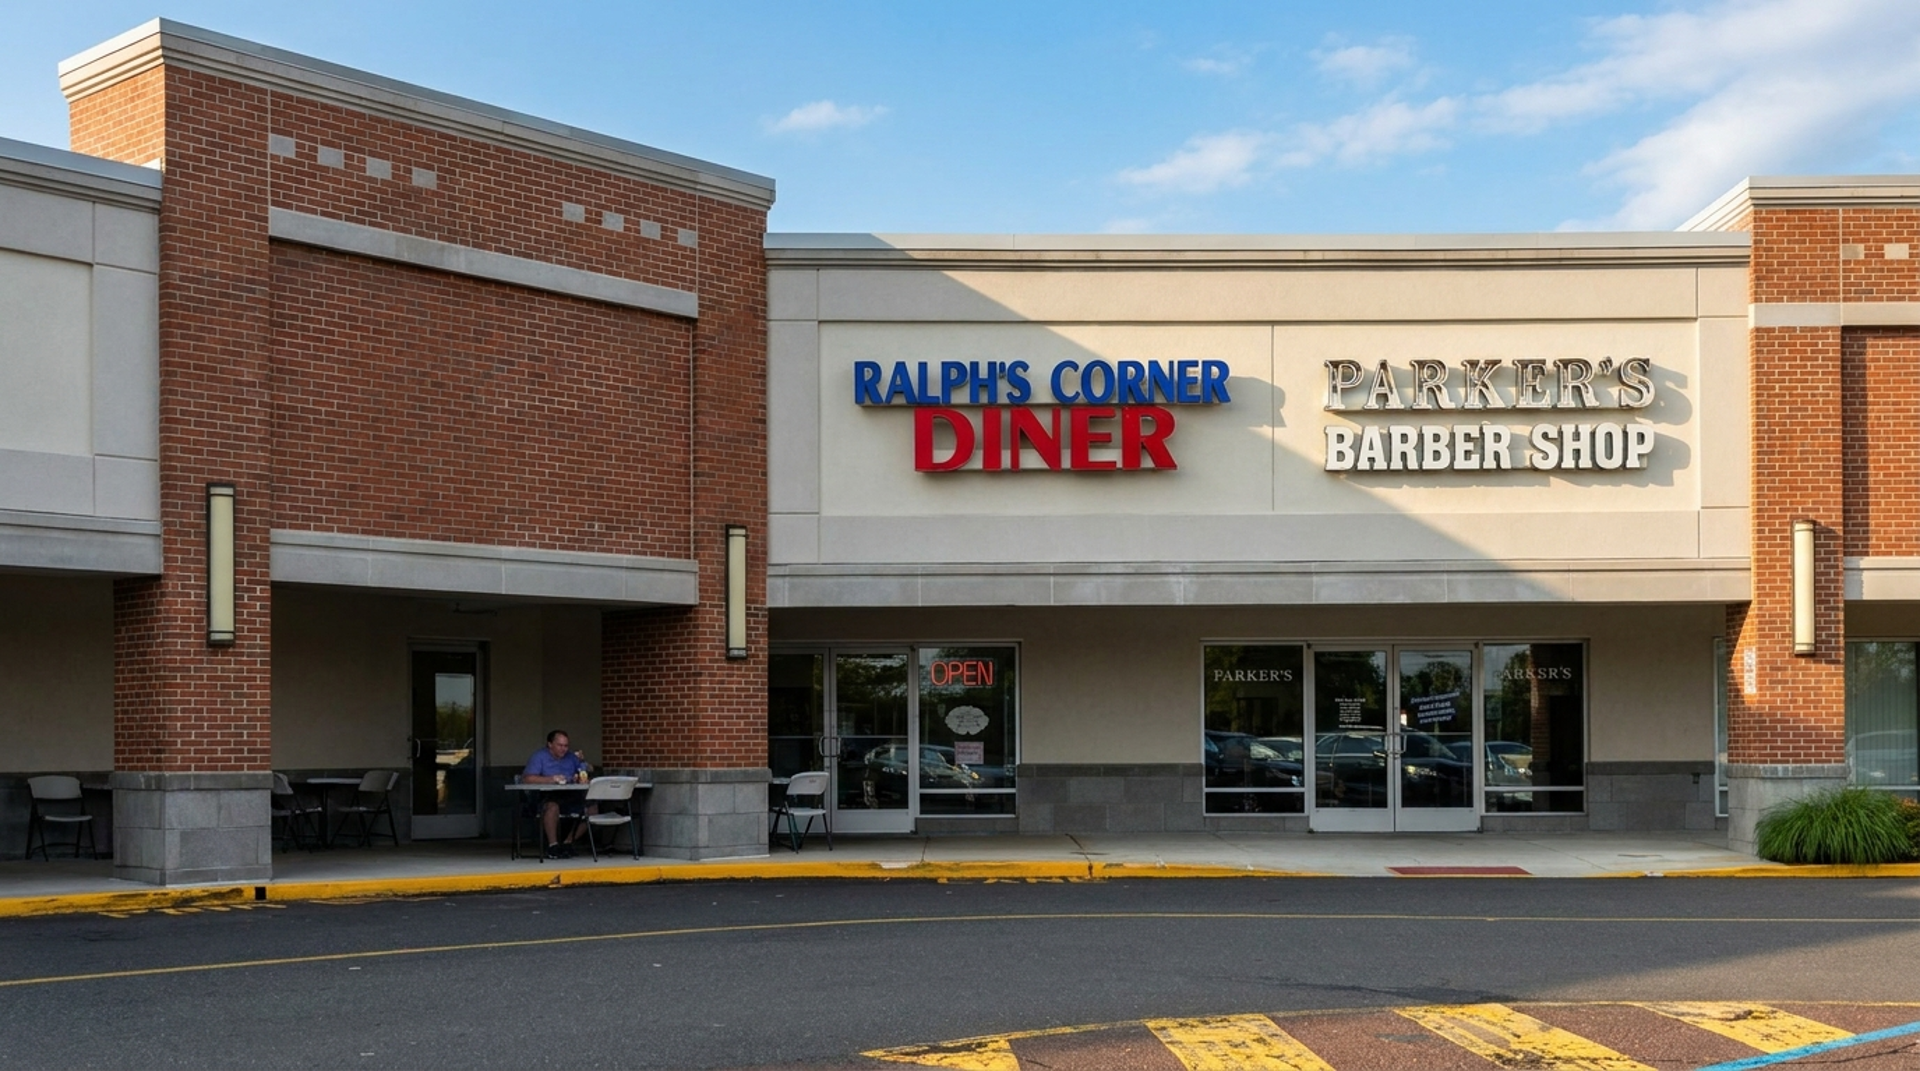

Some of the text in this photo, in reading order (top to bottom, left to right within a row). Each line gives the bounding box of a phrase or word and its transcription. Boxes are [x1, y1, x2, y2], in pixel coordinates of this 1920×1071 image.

[854, 360, 1232, 405] RALPH'S CORNER
[1324, 356, 1656, 411] PARKER'S
[914, 406, 1178, 471] DINER
[1324, 423, 1655, 471] BARBER SHOP
[931, 660, 994, 687] OPEN
[1213, 669, 1293, 682] PARKER'S
